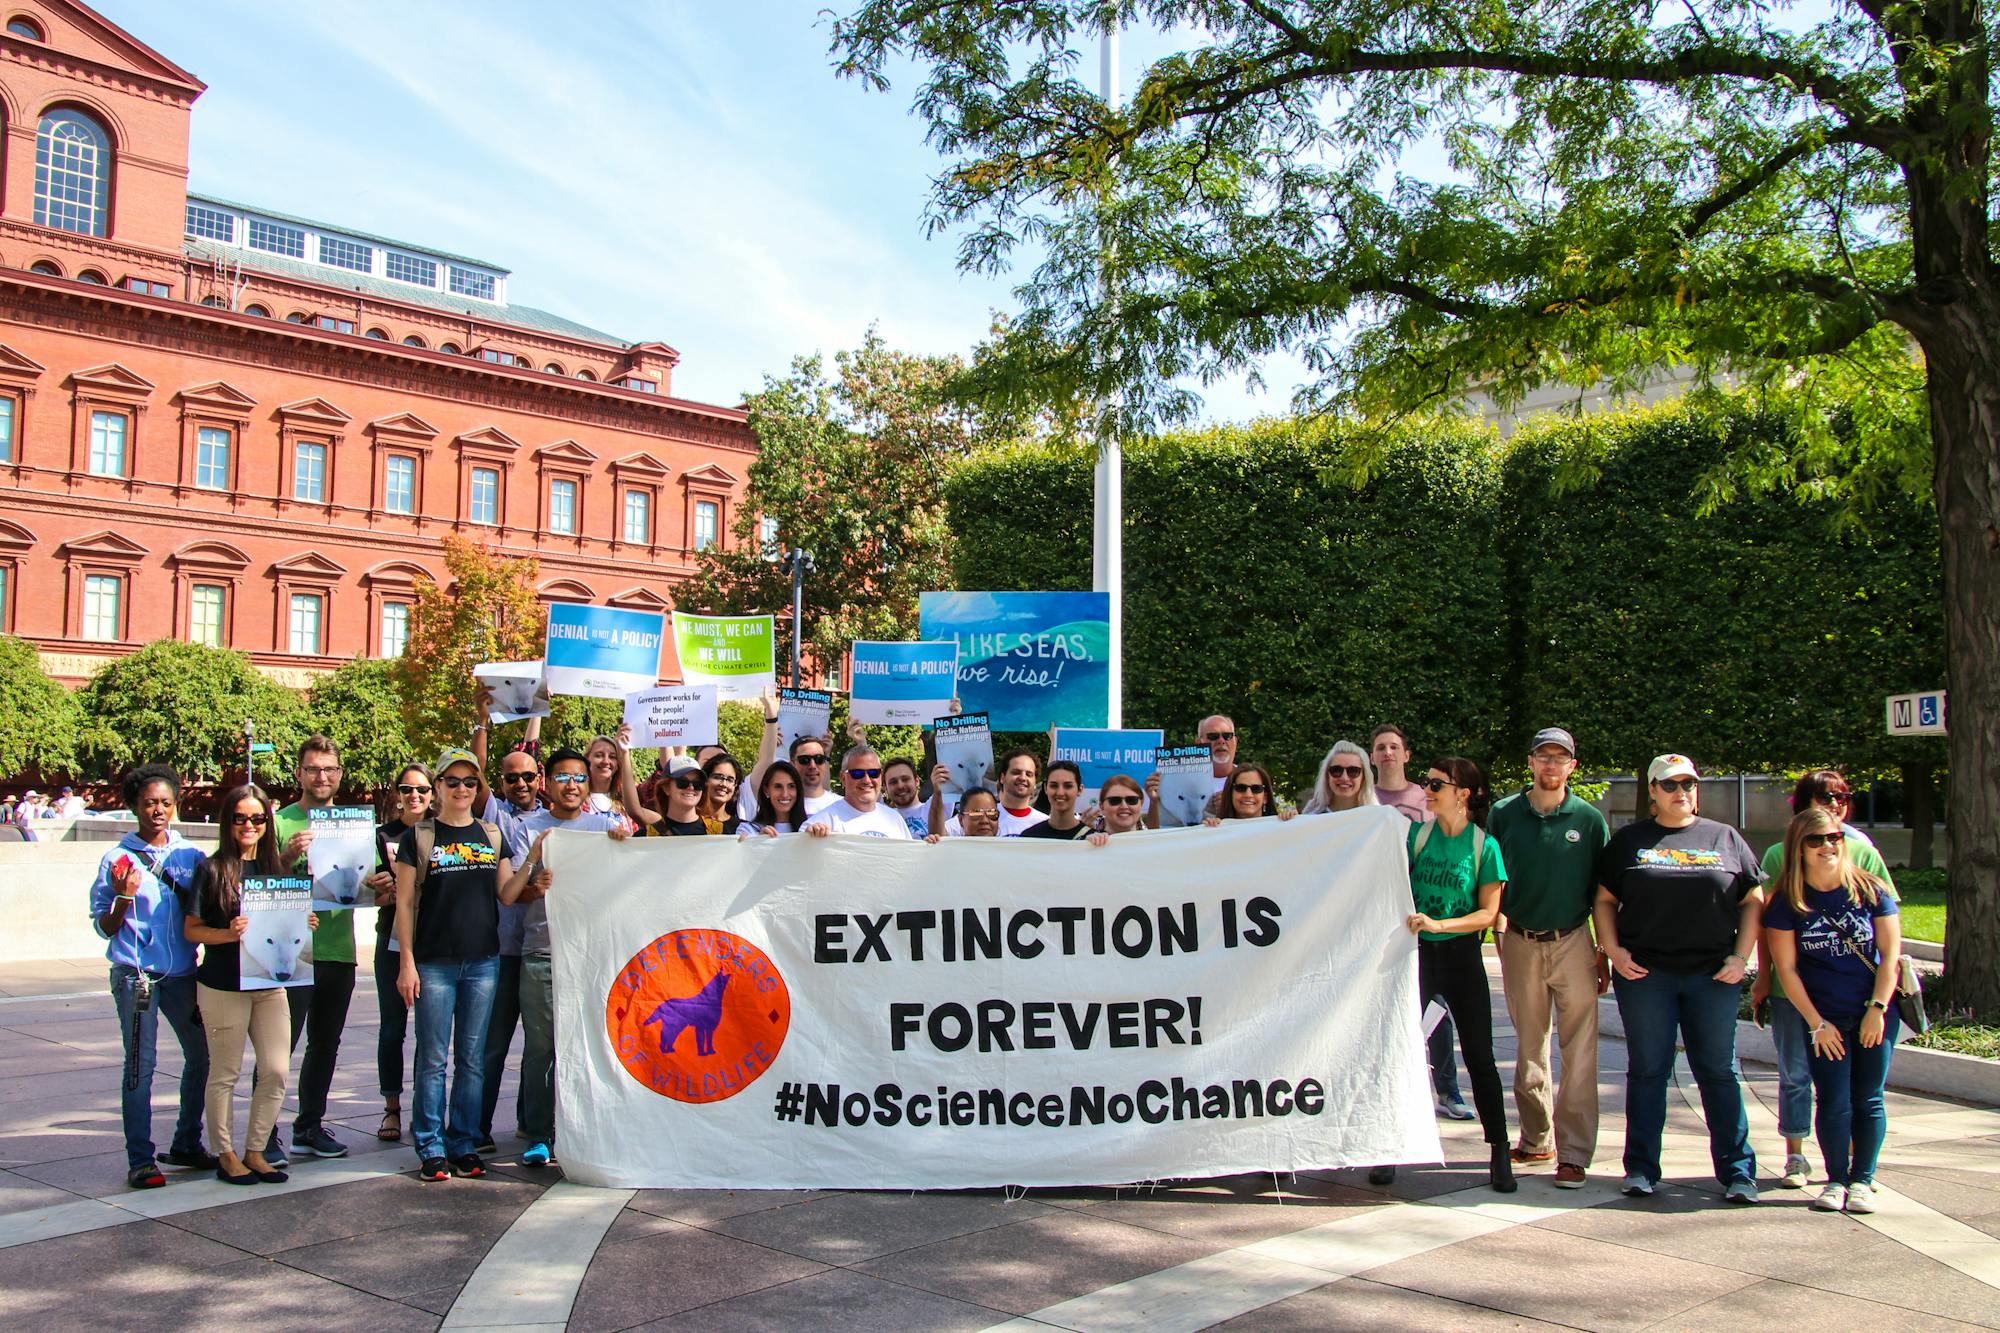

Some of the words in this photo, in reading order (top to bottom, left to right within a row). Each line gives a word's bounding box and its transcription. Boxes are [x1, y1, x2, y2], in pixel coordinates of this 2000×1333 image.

[680, 620, 693, 634] WE
[694, 622, 723, 638] MUST,
[725, 623, 741, 637] WE
[743, 623, 764, 637] CAN
[550, 623, 589, 640] DENIAL
[591, 629, 598, 638] IS
[598, 630, 609, 639] NOT
[610, 630, 618, 645] A
[621, 631, 660, 649] POLICY
[712, 638, 726, 647] AND
[954, 631, 1010, 658] LIKE
[1014, 632, 1094, 663] SEAS,
[698, 647, 715, 661] WE
[716, 648, 743, 662] WILL
[713, 663, 742, 671] CLIMATE
[743, 661, 766, 669] CRISIS
[854, 660, 890, 675] DENIAL
[892, 664, 899, 672] IS
[899, 664, 909, 672] NOT
[910, 662, 918, 675] A
[920, 661, 955, 674] POLICY
[957, 664, 991, 682] we
[998, 660, 1065, 688] rise!
[637, 694, 672, 704] Government
[673, 692, 691, 701] works
[692, 691, 701, 701] for
[782, 690, 796, 698] No
[797, 690, 831, 703] Drilling
[652, 705, 662, 713] the
[663, 704, 685, 715] people!
[780, 698, 802, 706] Arctic
[802, 700, 830, 709] National
[1895, 701, 1910, 726] M
[648, 717, 659, 726] Not
[660, 717, 689, 726] corporate
[935, 719, 950, 728] No
[951, 715, 987, 726] Drilling
[654, 728, 683, 739] polluters!
[936, 727, 958, 736] Arctic
[958, 724, 988, 734] National
[1057, 748, 1092, 762] DENIAL
[1094, 751, 1101, 759] IS
[1101, 751, 1112, 759] NOT
[1113, 749, 1121, 763] A
[1157, 749, 1171, 757] No
[1173, 746, 1210, 755] Drilling
[1157, 758, 1179, 766] Arctic
[1180, 755, 1211, 765] National
[309, 809, 328, 819] No
[331, 808, 373, 819] Drilling
[310, 820, 337, 829] Arctic
[338, 820, 373, 829] National
[1420, 856, 1448, 869] stand
[430, 866, 468, 876] DEFENDERS
[244, 879, 263, 890] No
[266, 878, 311, 889] Drilling
[243, 891, 272, 901] Arctic
[274, 890, 311, 900] National
[243, 901, 278, 912] Wildlife
[280, 901, 311, 911] Refuge
[814, 902, 1199, 964] EXTINCTION
[1222, 897, 1282, 949] IS
[1802, 940, 1830, 951] There
[1831, 937, 1840, 946] is
[622, 933, 777, 993] DEFENDERS
[890, 997, 1203, 1053] FOREVER!
[619, 1035, 648, 1067] OF
[652, 1041, 772, 1097] WILDLIFE
[774, 1077, 1325, 1128] #NoScienceNoChance
